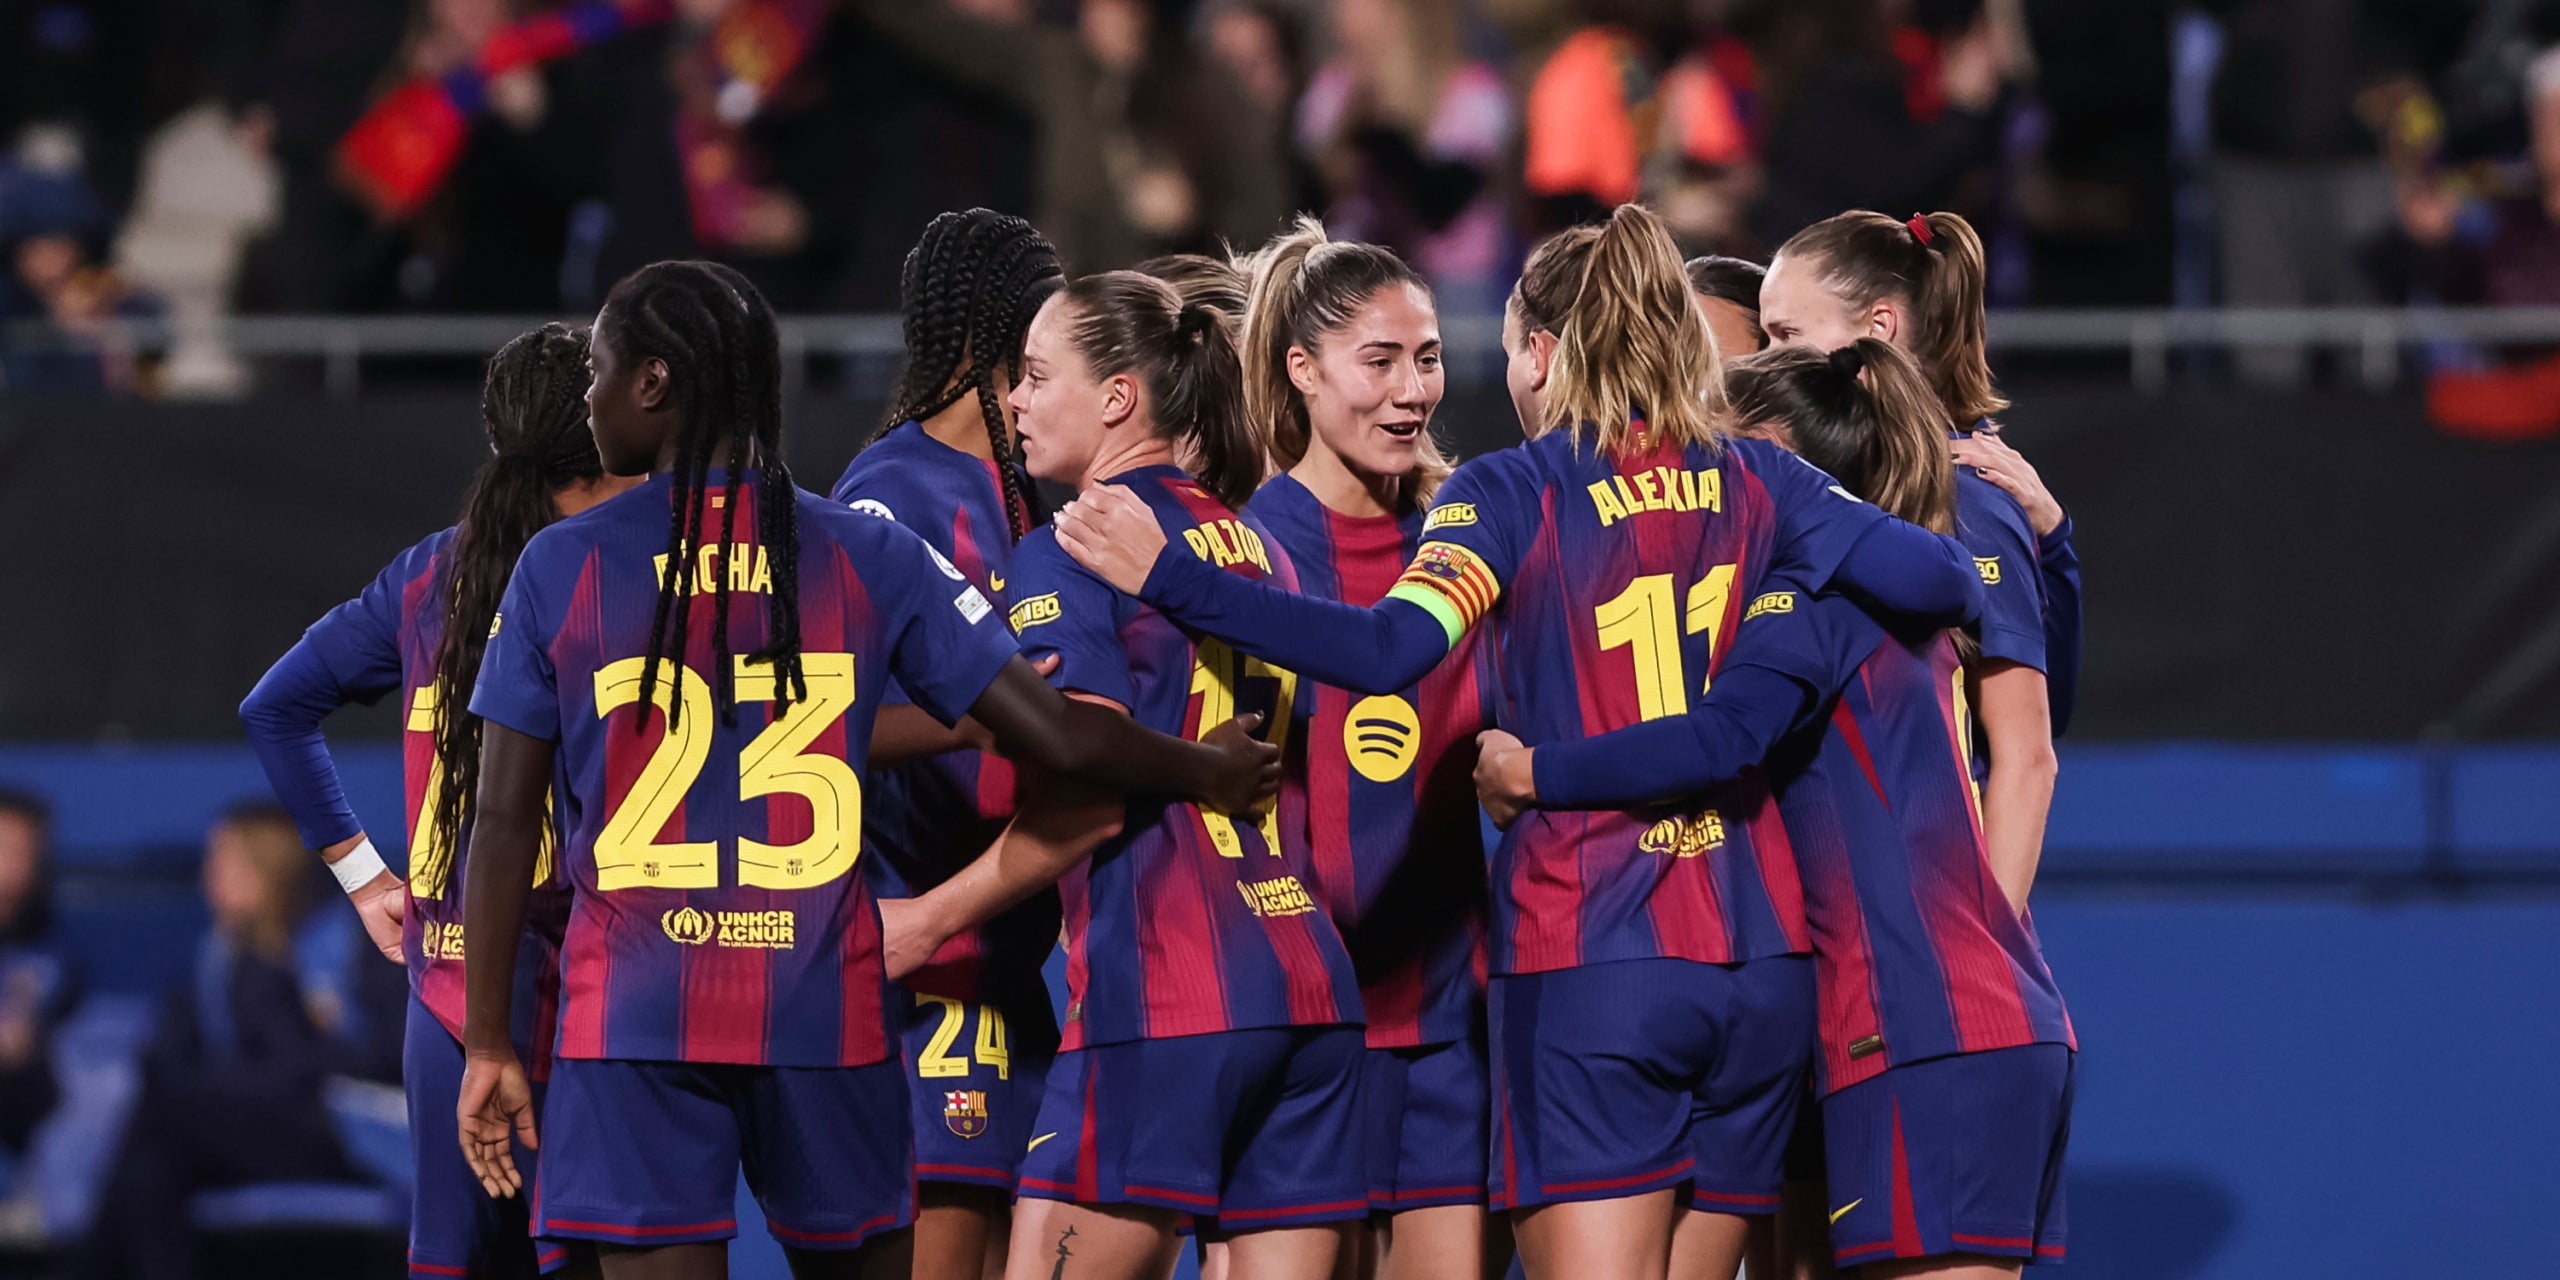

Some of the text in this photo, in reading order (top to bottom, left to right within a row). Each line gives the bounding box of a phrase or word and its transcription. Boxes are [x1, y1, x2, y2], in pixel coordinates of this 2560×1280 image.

[1587, 466, 1721, 527] ALEXIA
[1430, 506, 1476, 526] MBO
[1182, 519, 1272, 575] PAJOR
[1747, 594, 1794, 617] MBO
[1189, 634, 1297, 859] 17
[593, 653, 862, 891] 23
[1680, 825, 1725, 851] CNUR
[1253, 876, 1304, 897] UNHC
[718, 911, 795, 926] UNHCR
[717, 926, 795, 941] ACNUR
[915, 992, 1008, 1080] 24
